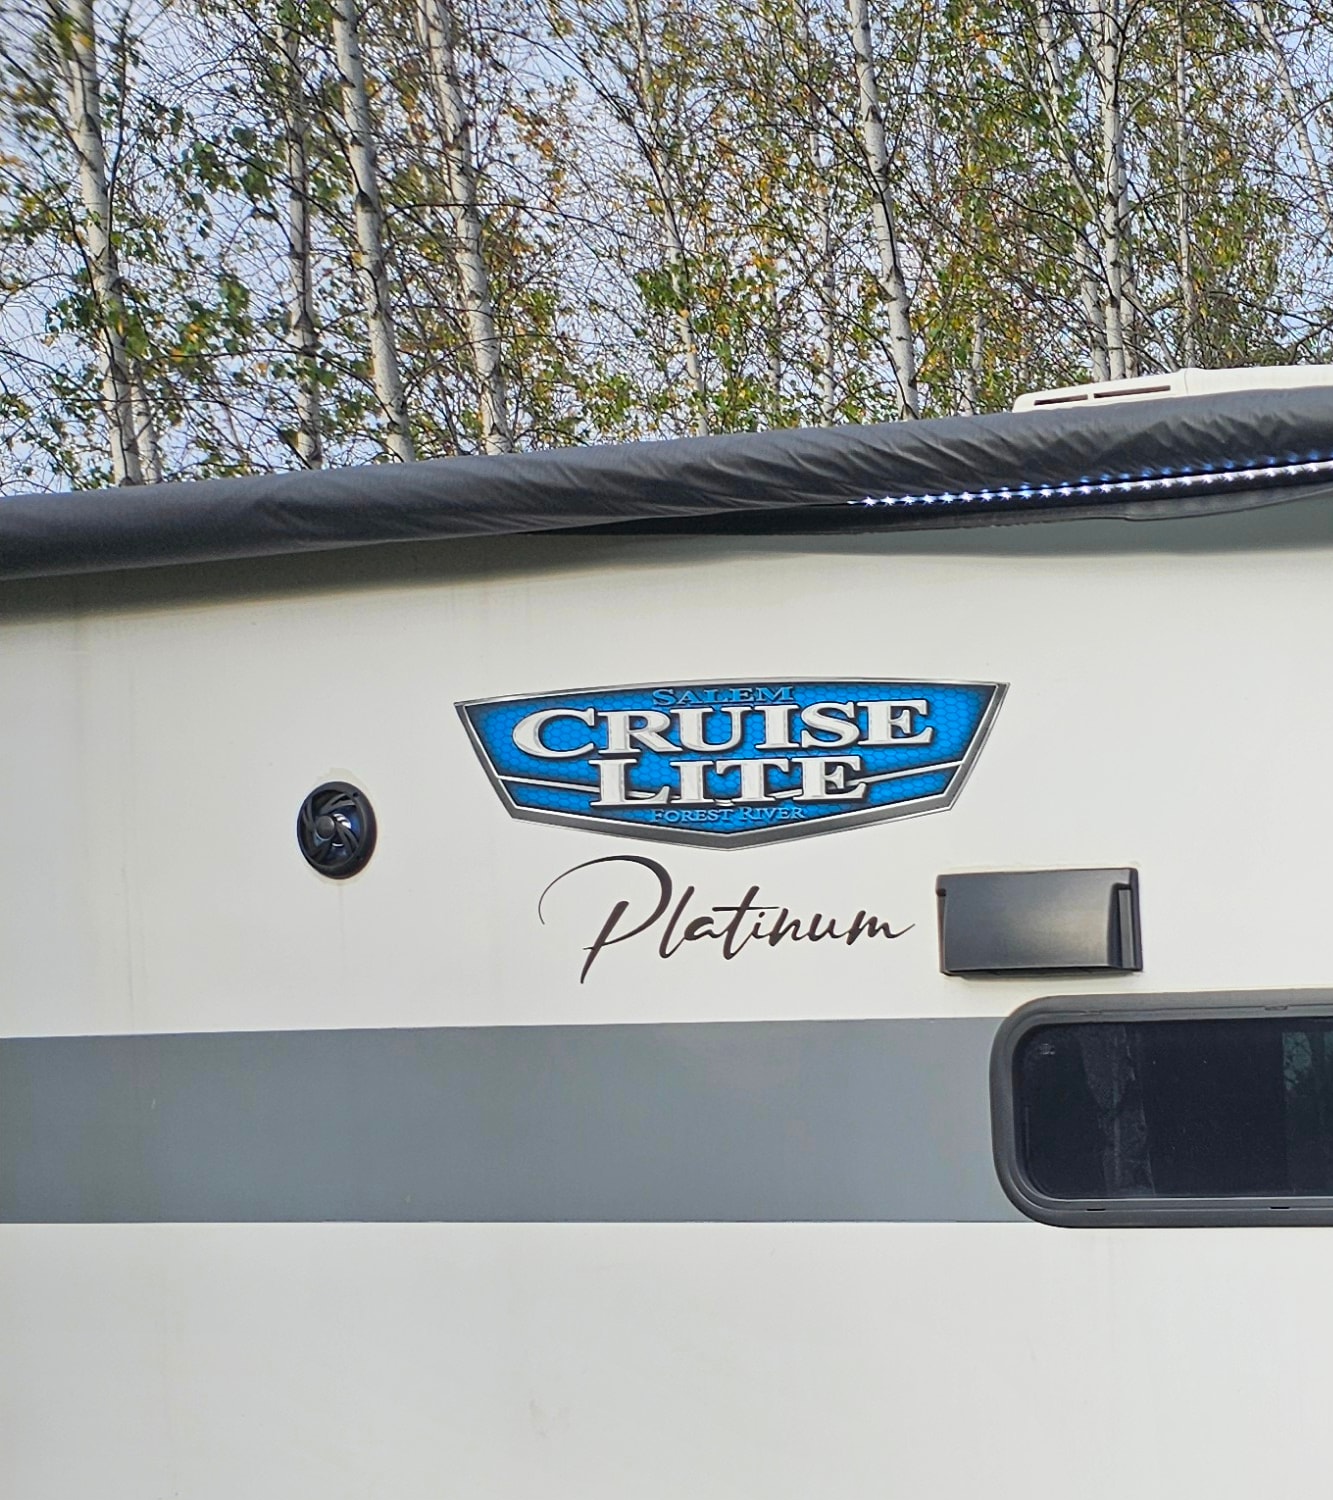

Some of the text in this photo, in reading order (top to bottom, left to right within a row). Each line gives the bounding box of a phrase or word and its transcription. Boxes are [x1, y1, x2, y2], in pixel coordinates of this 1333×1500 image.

[652, 686, 794, 706] SALEM
[511, 698, 933, 760] CRUISE
[589, 754, 868, 808] LITE
[650, 806, 806, 823] FOREST RIVER
[538, 855, 916, 985] Platinum
